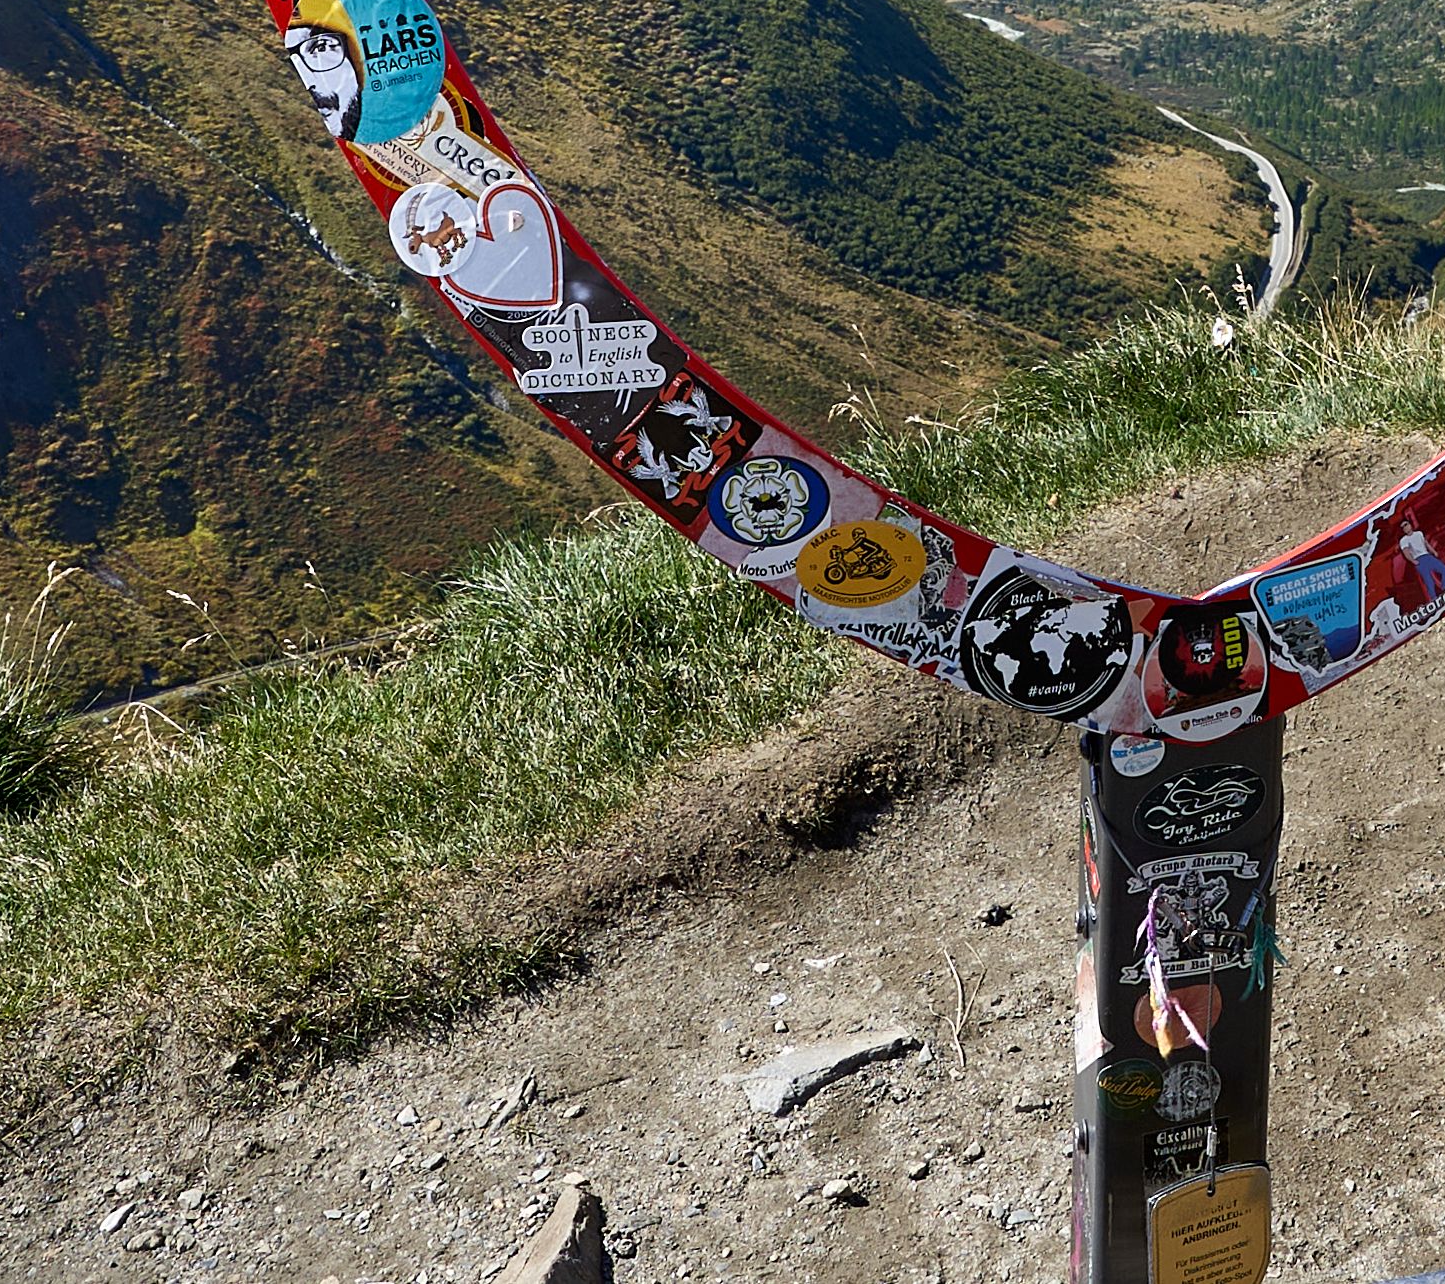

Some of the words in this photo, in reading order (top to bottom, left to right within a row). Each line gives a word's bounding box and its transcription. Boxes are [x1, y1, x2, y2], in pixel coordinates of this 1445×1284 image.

[360, 25, 437, 61] LARS
[366, 48, 442, 77] KRACHEN
[558, 351, 573, 364] to
[588, 346, 643, 367] English
[527, 368, 660, 390] DICTIONARY
[812, 584, 869, 606] MAASTRICHTSE
[867, 577, 914, 605] MOTORCLUB
[1273, 578, 1307, 595] GREAT
[1309, 564, 1348, 584] SMOKY
[1273, 574, 1349, 605] MOUNTAINS
[1009, 591, 1045, 607] Black
[1026, 681, 1077, 698] #vanjoy
[1162, 823, 1195, 841] Joy
[1200, 809, 1244, 828] Ride
[1150, 858, 1187, 876] Grupo
[1190, 853, 1236, 870] Motard
[1170, 1223, 1195, 1239] HIER
[1182, 1220, 1242, 1247] ANBRINGEN.
[1183, 1251, 1243, 1278] Diskriminierung
[1225, 1260, 1245, 1274] auch
